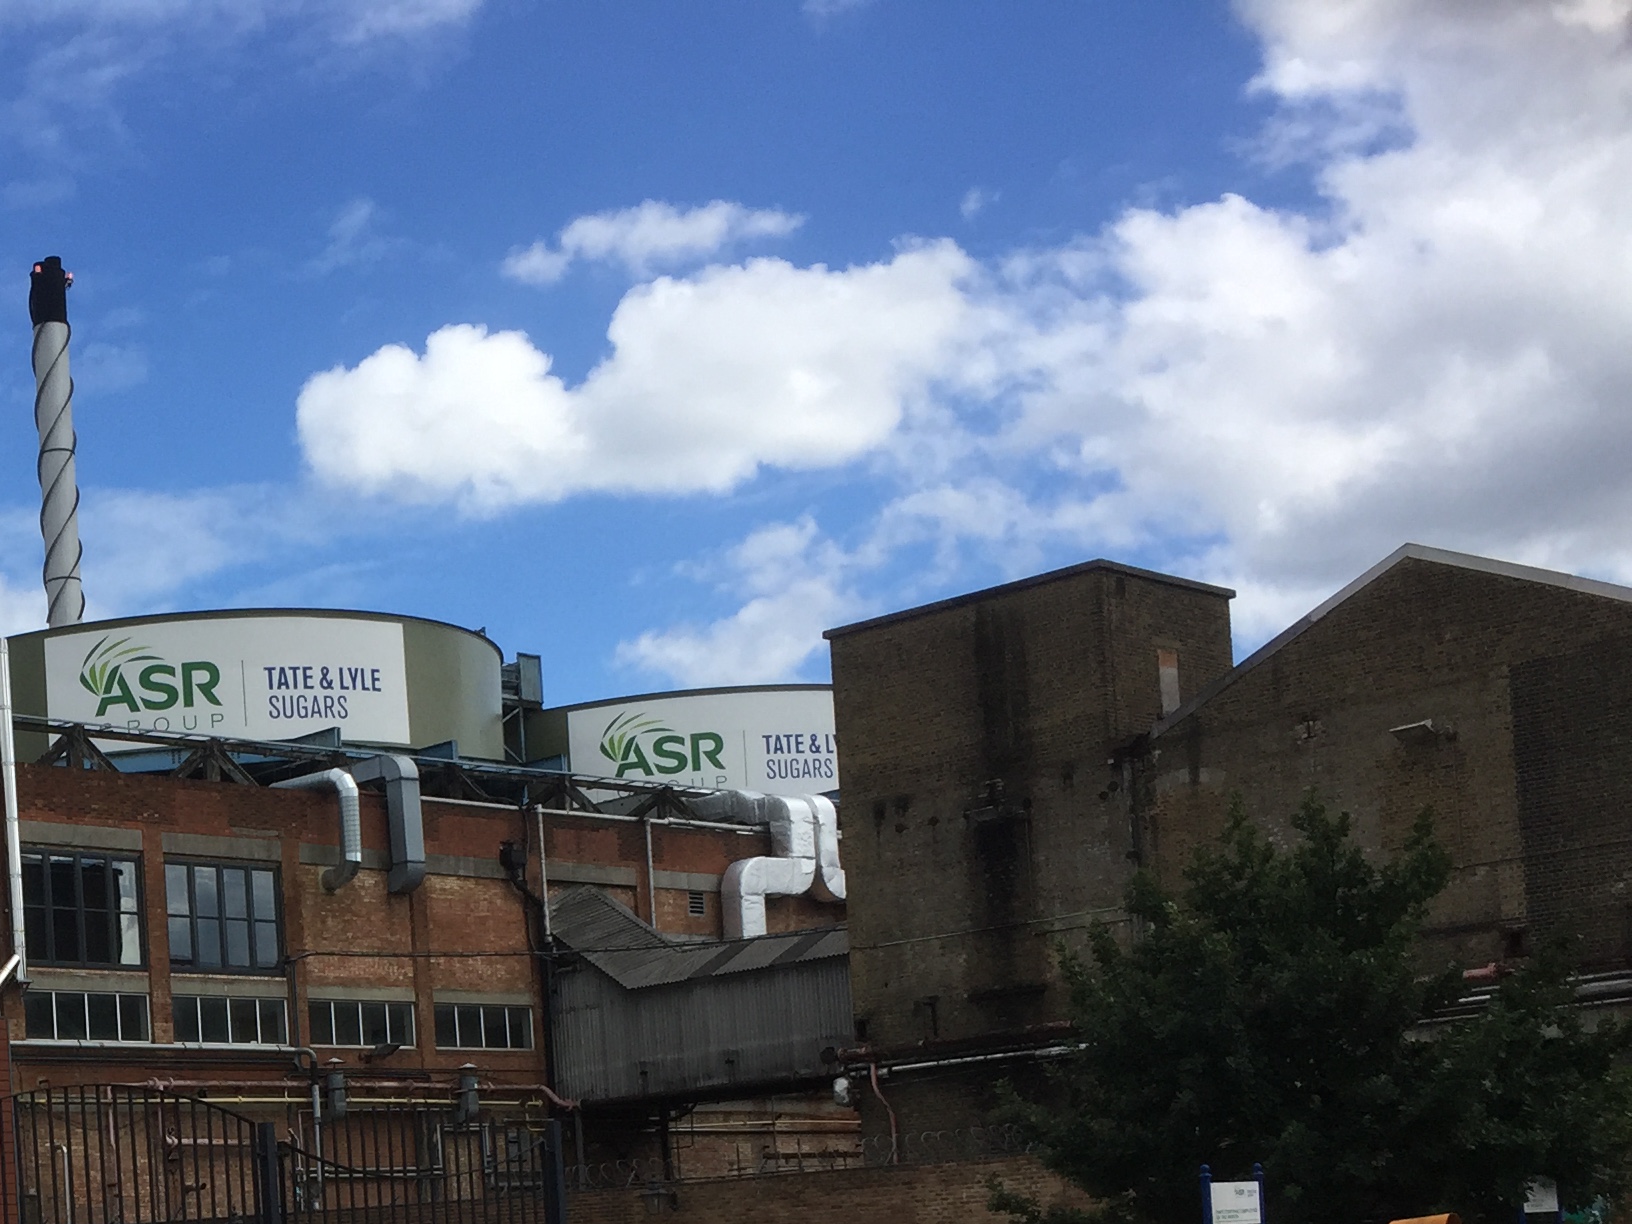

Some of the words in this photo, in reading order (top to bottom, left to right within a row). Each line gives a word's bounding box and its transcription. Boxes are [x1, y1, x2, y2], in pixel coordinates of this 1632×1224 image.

[95, 661, 224, 718] ASR
[264, 666, 314, 692] TATE
[319, 666, 335, 691] &
[338, 667, 382, 693] LYLE
[268, 695, 349, 720] SUGARS
[614, 732, 726, 779] ASR
[762, 734, 805, 755] TATE
[809, 733, 822, 754] &
[766, 758, 834, 780] SUGARS
